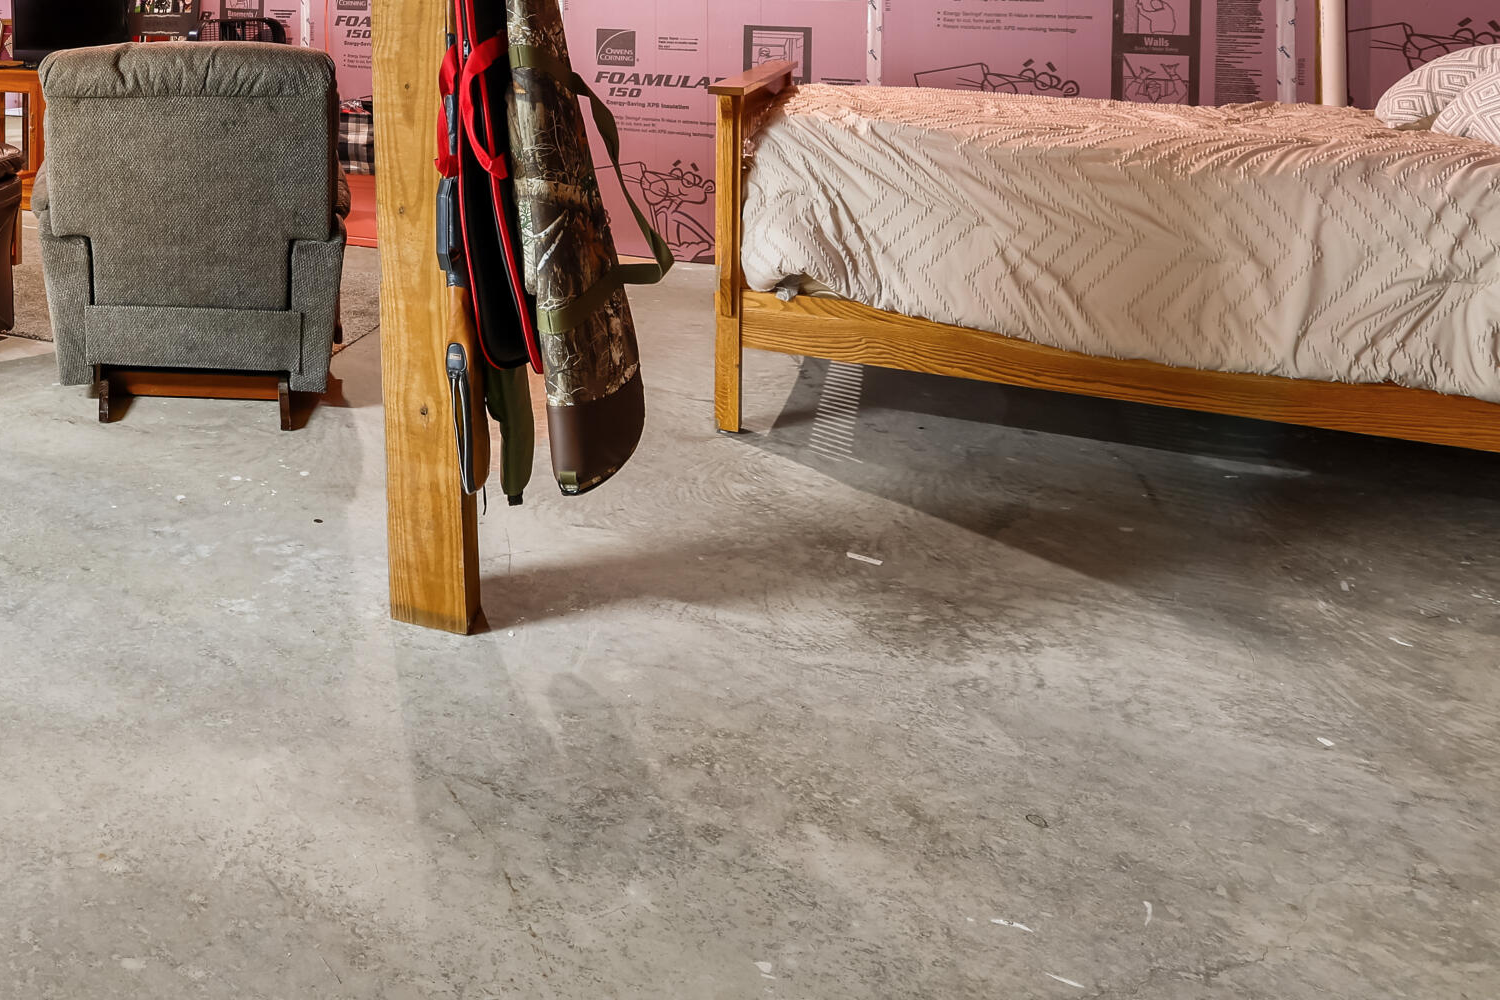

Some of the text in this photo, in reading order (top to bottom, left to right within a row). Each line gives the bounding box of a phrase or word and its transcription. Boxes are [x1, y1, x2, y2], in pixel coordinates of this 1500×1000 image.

[1143, 36, 1170, 47] Walls
[599, 53, 634, 62] CORNING
[594, 71, 727, 89] FOAMULA
[608, 87, 642, 98] 150
